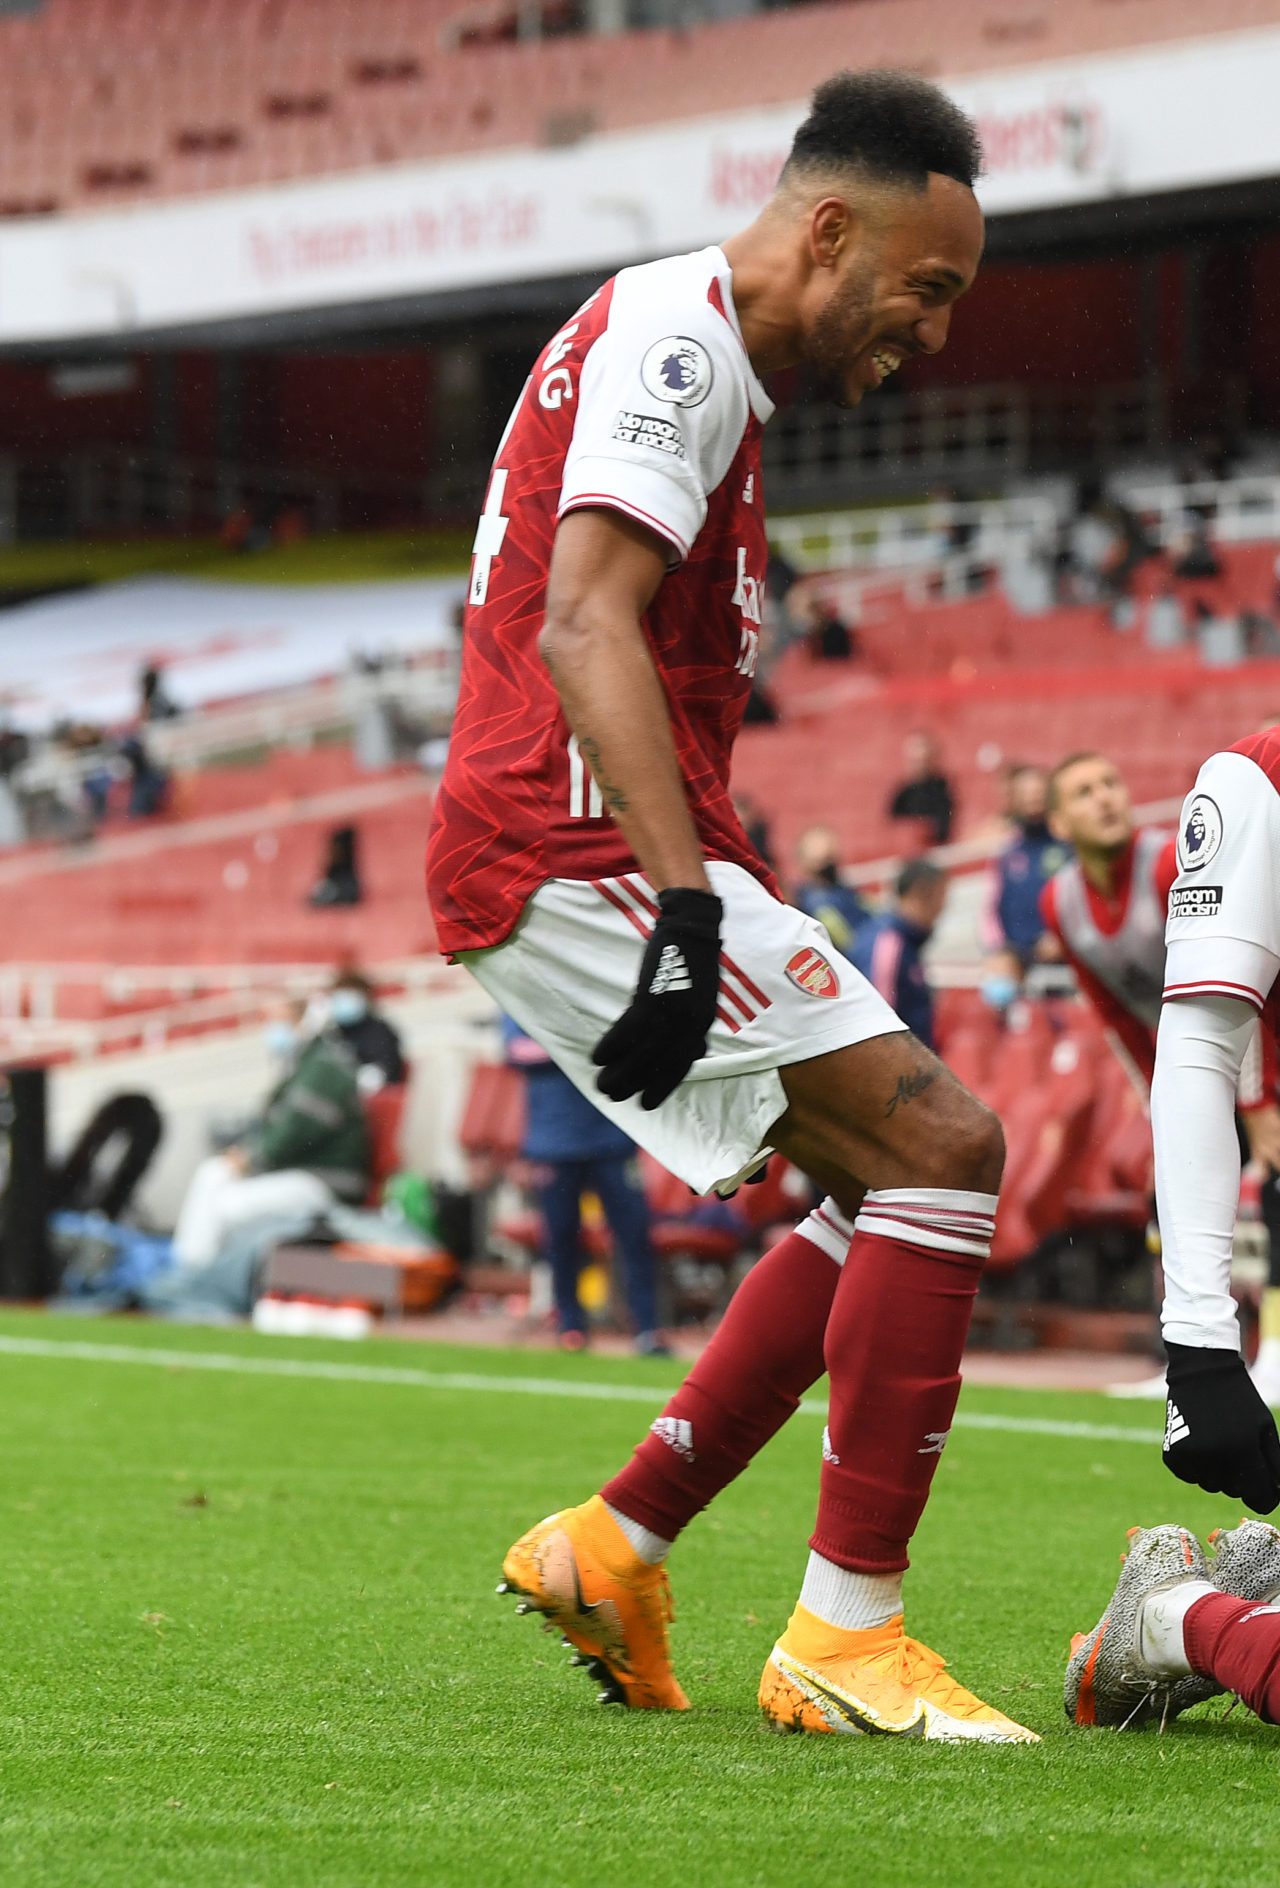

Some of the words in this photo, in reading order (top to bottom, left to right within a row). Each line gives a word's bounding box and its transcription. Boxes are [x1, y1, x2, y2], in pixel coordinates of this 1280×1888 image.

[617, 410, 642, 429] No
[613, 428, 638, 442] or
[1180, 889, 1217, 904] room
